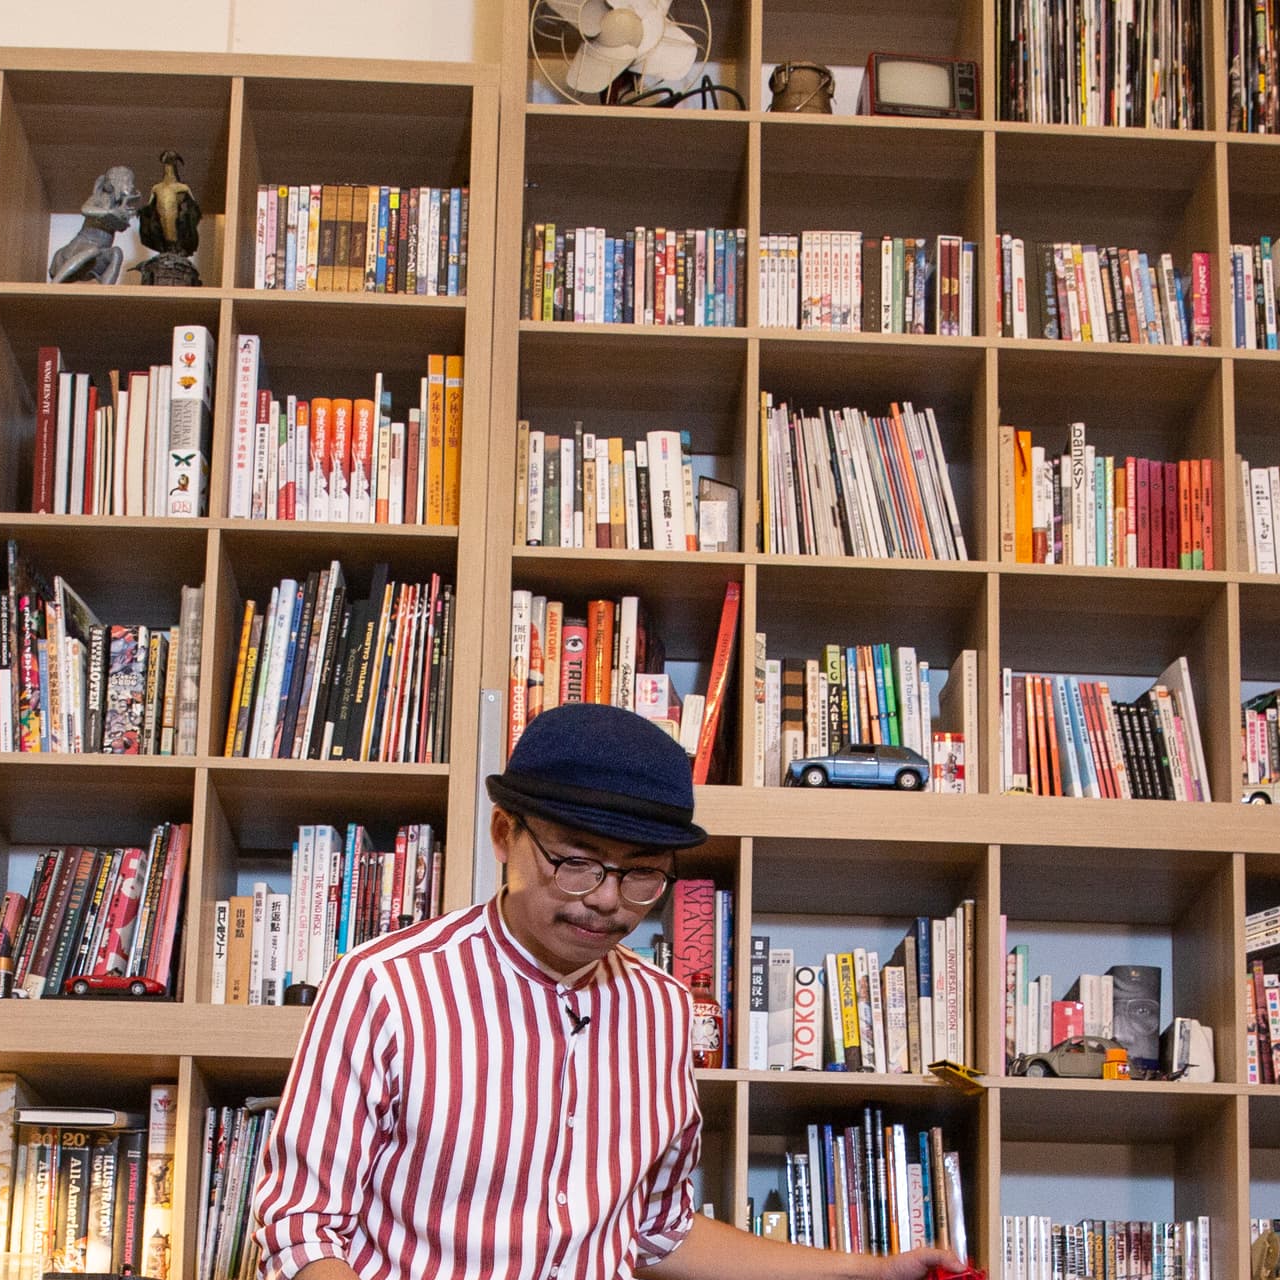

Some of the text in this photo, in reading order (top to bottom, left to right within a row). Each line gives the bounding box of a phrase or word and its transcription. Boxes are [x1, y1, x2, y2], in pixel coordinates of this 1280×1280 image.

[44, 360, 53, 383] WANG
[172, 400, 181, 447] HISTORY
[181, 400, 192, 447] NATURAL
[1072, 425, 1084, 490] banksy
[513, 625, 526, 633] THE
[514, 634, 526, 643] ART
[549, 610, 557, 662] ANATOMY
[597, 609, 607, 626] The
[355, 621, 376, 704] PERPETUAL CALENDAR
[567, 659, 583, 705] TRUE
[512, 685, 524, 722] DOUG
[829, 685, 840, 732] SMART
[904, 659, 915, 716] 2015 Taiwan
[77, 850, 94, 880] AKIRA
[69, 880, 87, 909] CLUB
[314, 890, 324, 913] WIND
[313, 914, 323, 936] RISES
[675, 882, 702, 979] MANGA
[700, 881, 714, 981] HOKUSA
[751, 966, 764, 1008] 画说汉字
[948, 948, 957, 1030] UNIVERSAL DESIGN
[793, 966, 816, 1062] YOKOO
[101, 1154, 116, 1238] ILLUSTRATION
[124, 1162, 139, 1264] JAPANESE ILLUSTRATION
